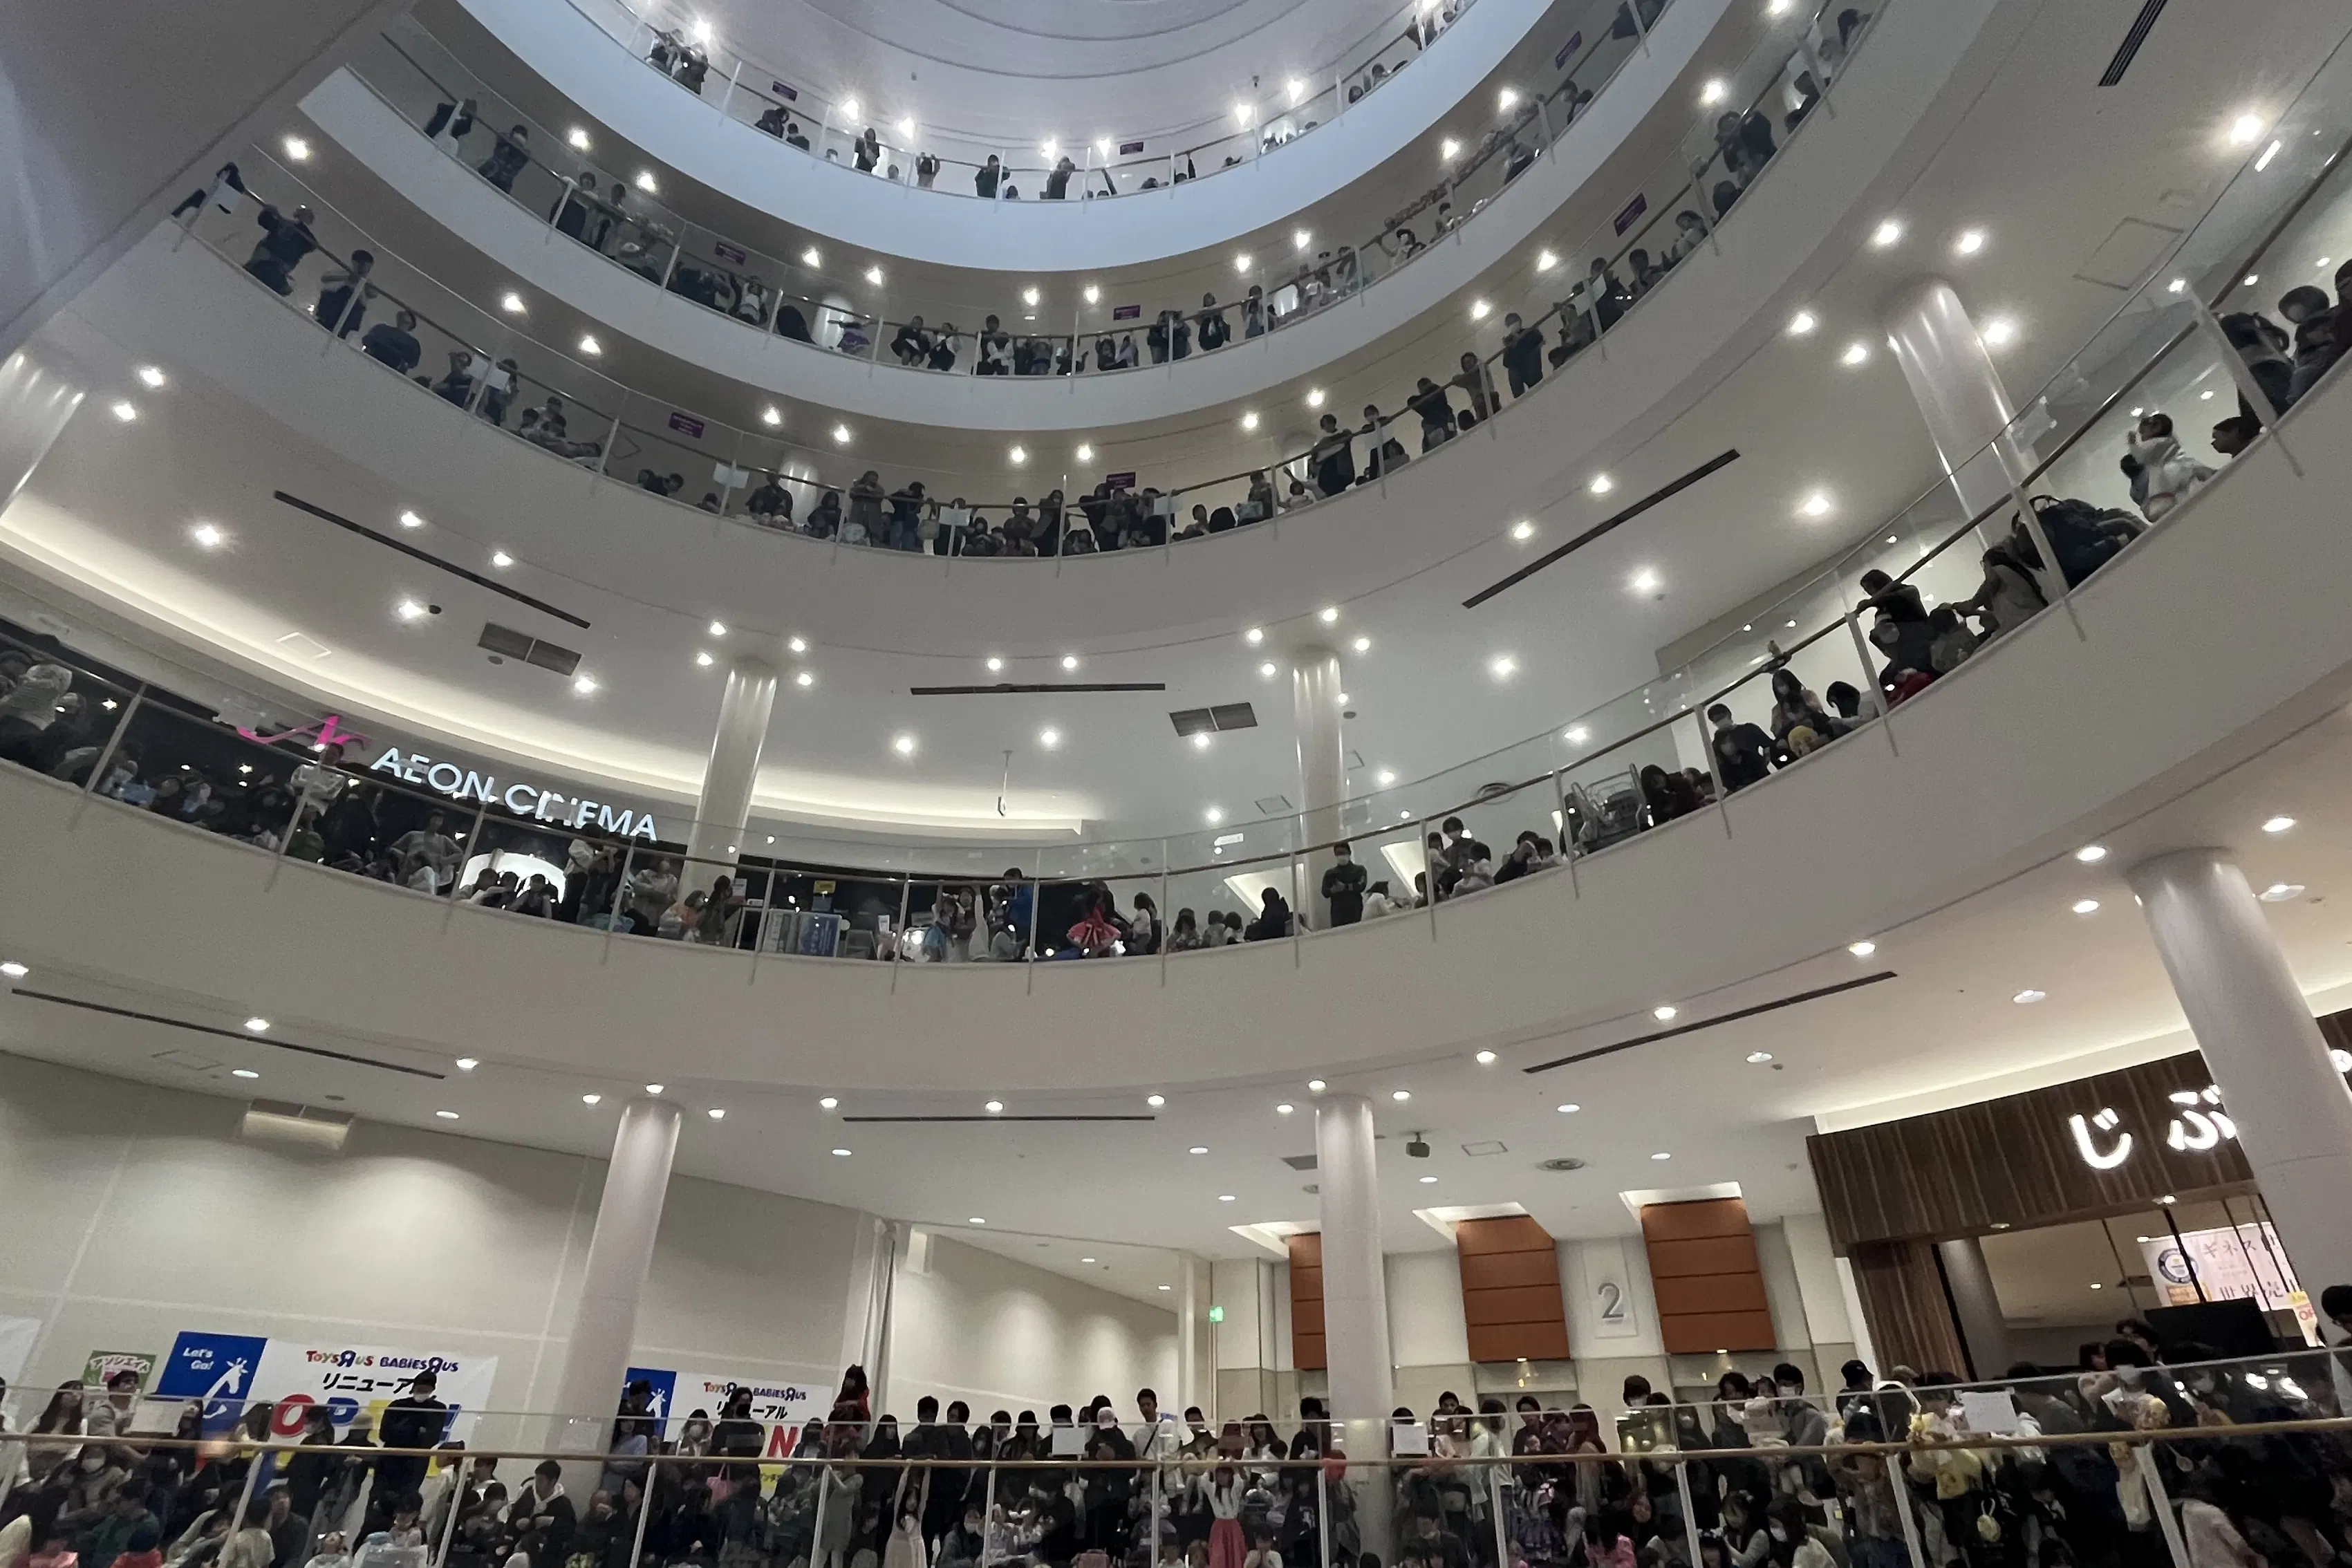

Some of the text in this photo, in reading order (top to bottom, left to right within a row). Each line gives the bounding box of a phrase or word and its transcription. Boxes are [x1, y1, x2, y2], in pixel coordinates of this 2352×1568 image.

[371, 747, 495, 802] AEON
[1598, 1282, 1624, 1319] 2
[183, 1347, 214, 1358] Let's
[323, 1373, 436, 1399] リニューア
